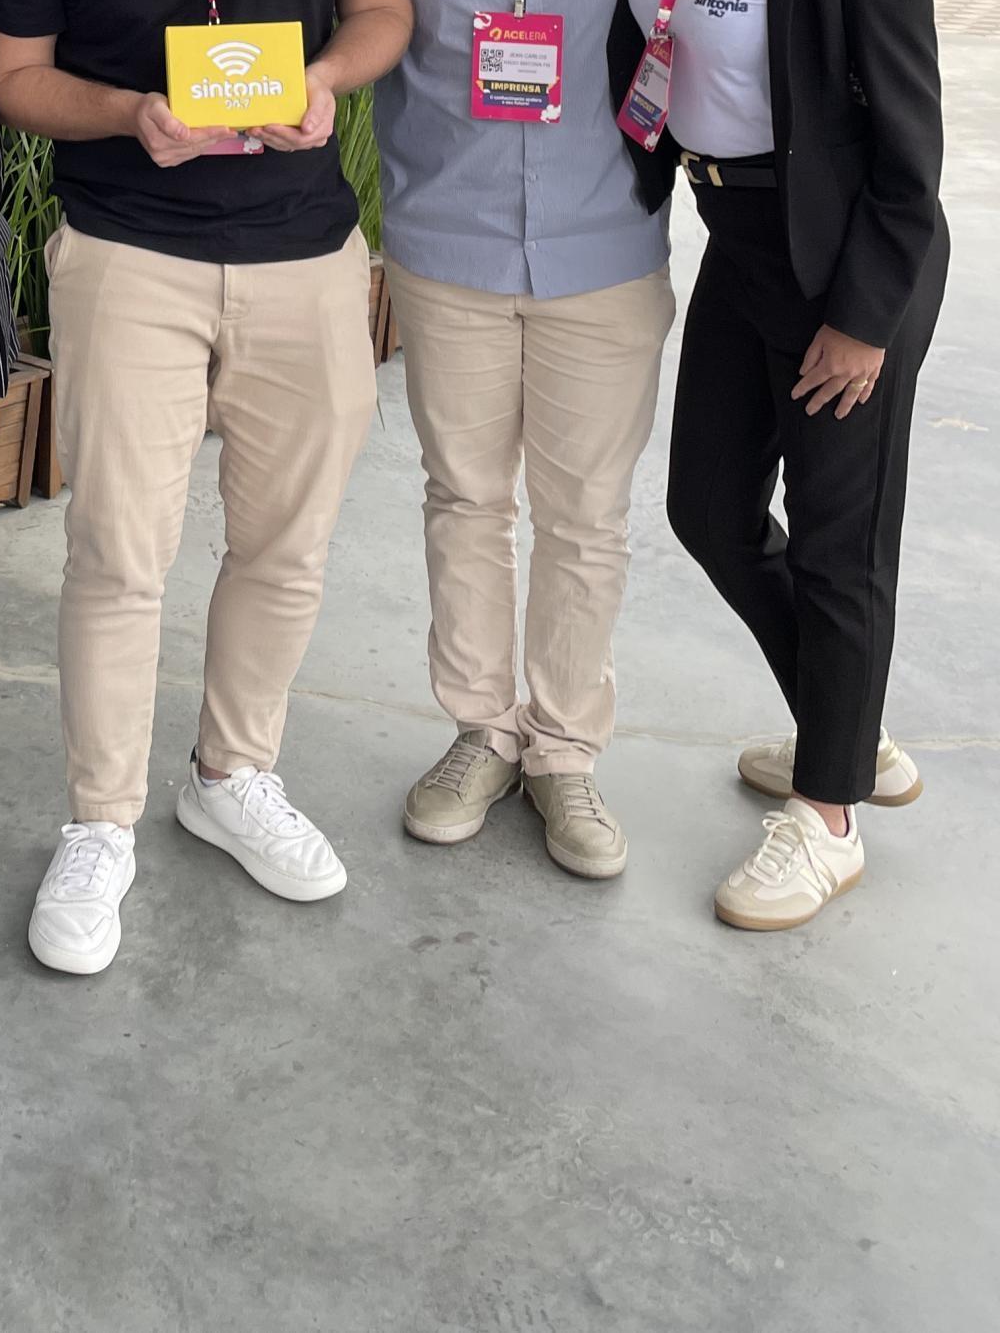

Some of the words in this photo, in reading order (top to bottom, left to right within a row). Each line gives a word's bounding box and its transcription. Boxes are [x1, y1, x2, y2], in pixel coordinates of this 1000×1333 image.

[504, 30, 547, 41] ACELERA
[191, 75, 283, 99] sintonia
[491, 82, 541, 93] IMPRENSA
